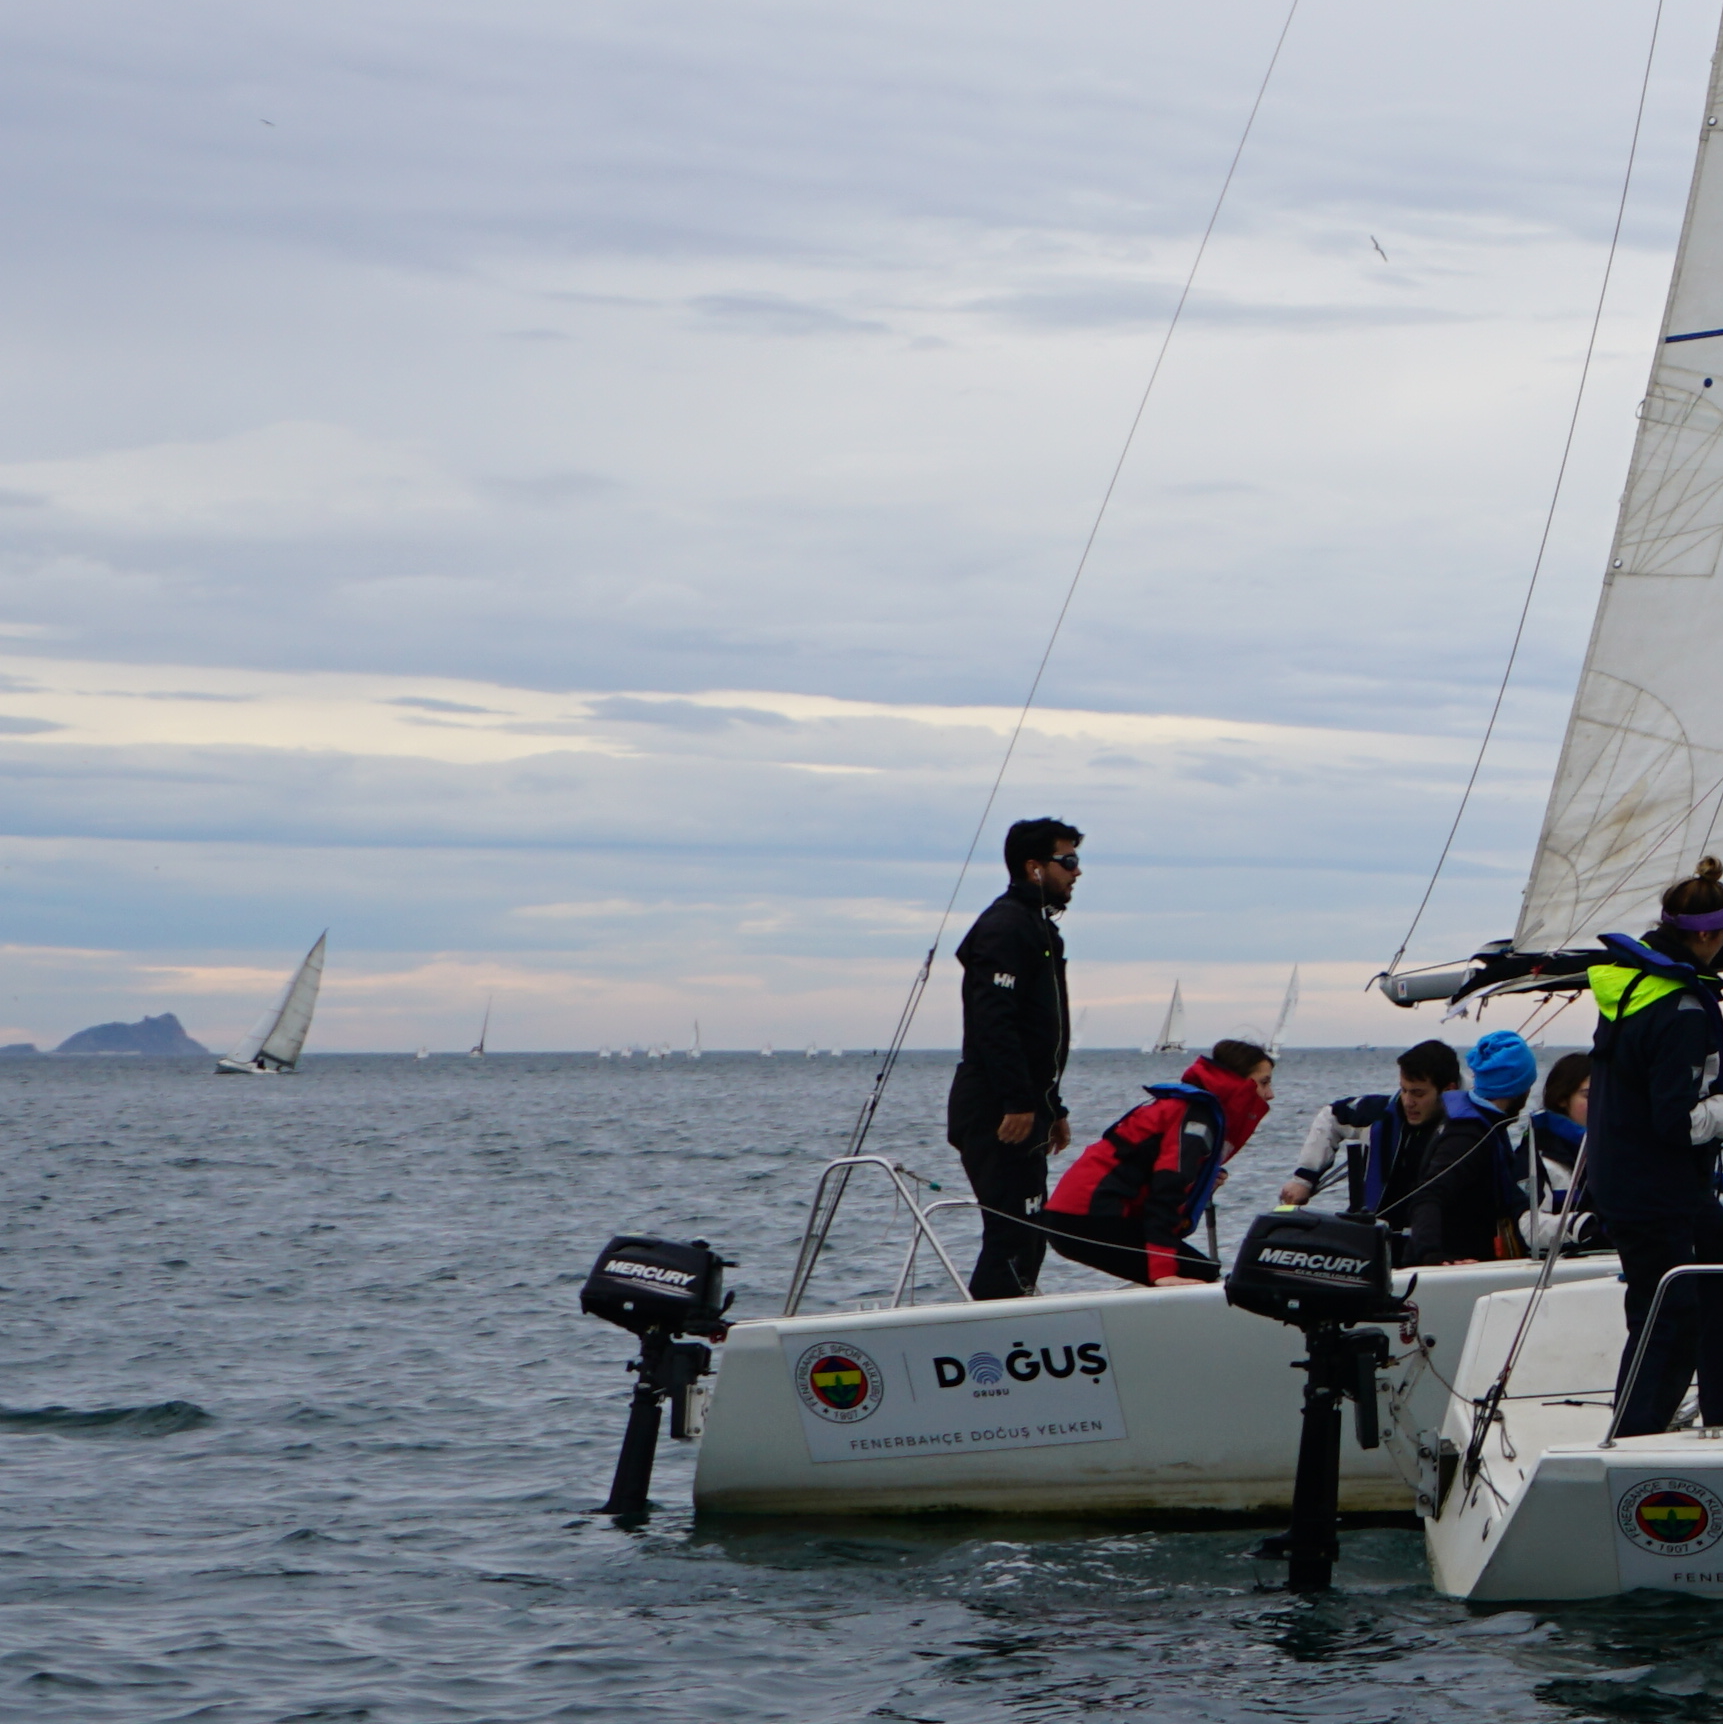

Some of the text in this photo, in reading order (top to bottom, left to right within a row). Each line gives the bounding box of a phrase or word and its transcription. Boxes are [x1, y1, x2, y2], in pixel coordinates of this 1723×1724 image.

[604, 1260, 696, 1285] MERCURY
[1258, 1248, 1371, 1273] MERCURY
[933, 1341, 1107, 1388] DOĞUŞ
[851, 1432, 963, 1450] FENERBAHÇE
[1037, 1420, 1102, 1435] YELKEN
[1660, 1543, 1689, 1554] 1907
